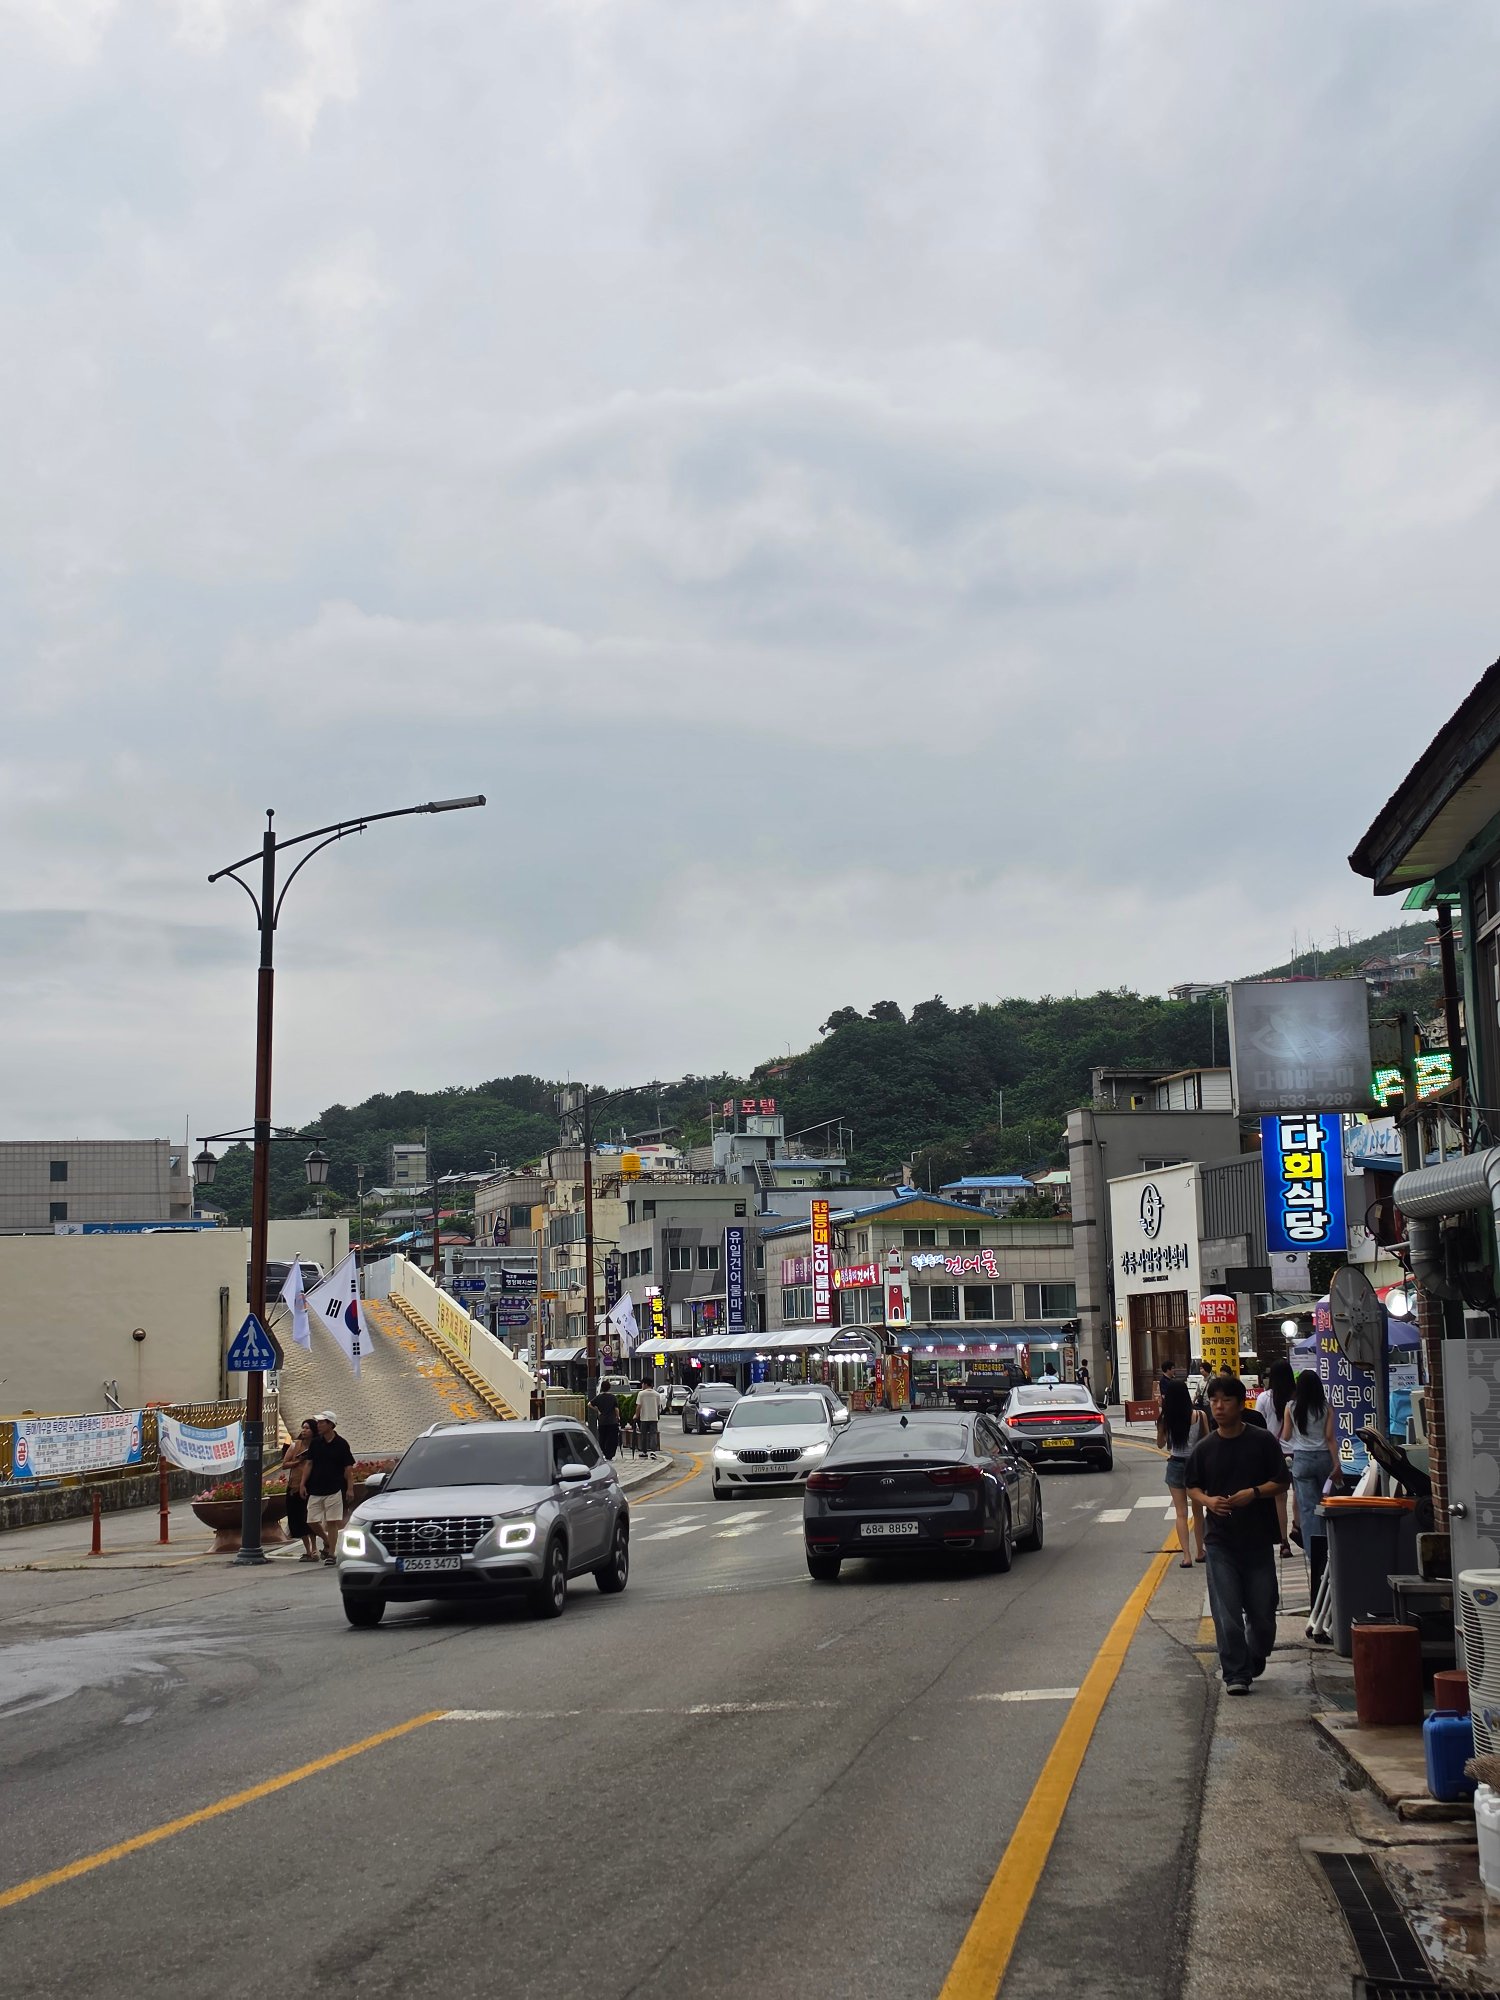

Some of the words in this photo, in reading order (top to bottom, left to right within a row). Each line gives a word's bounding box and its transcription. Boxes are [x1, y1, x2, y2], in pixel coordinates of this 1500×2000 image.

[1254, 1068, 1355, 1090] 다이버구이
[740, 1098, 776, 1115] 모텔
[1279, 1092, 1353, 1108] 533-9289
[945, 1249, 1000, 1278] 건어물
[728, 1230, 743, 1323] 유일건어물마트
[234, 1359, 268, 1368] 횡단보도
[888, 1523, 914, 1534] 8859
[433, 1557, 459, 1568] 3473
